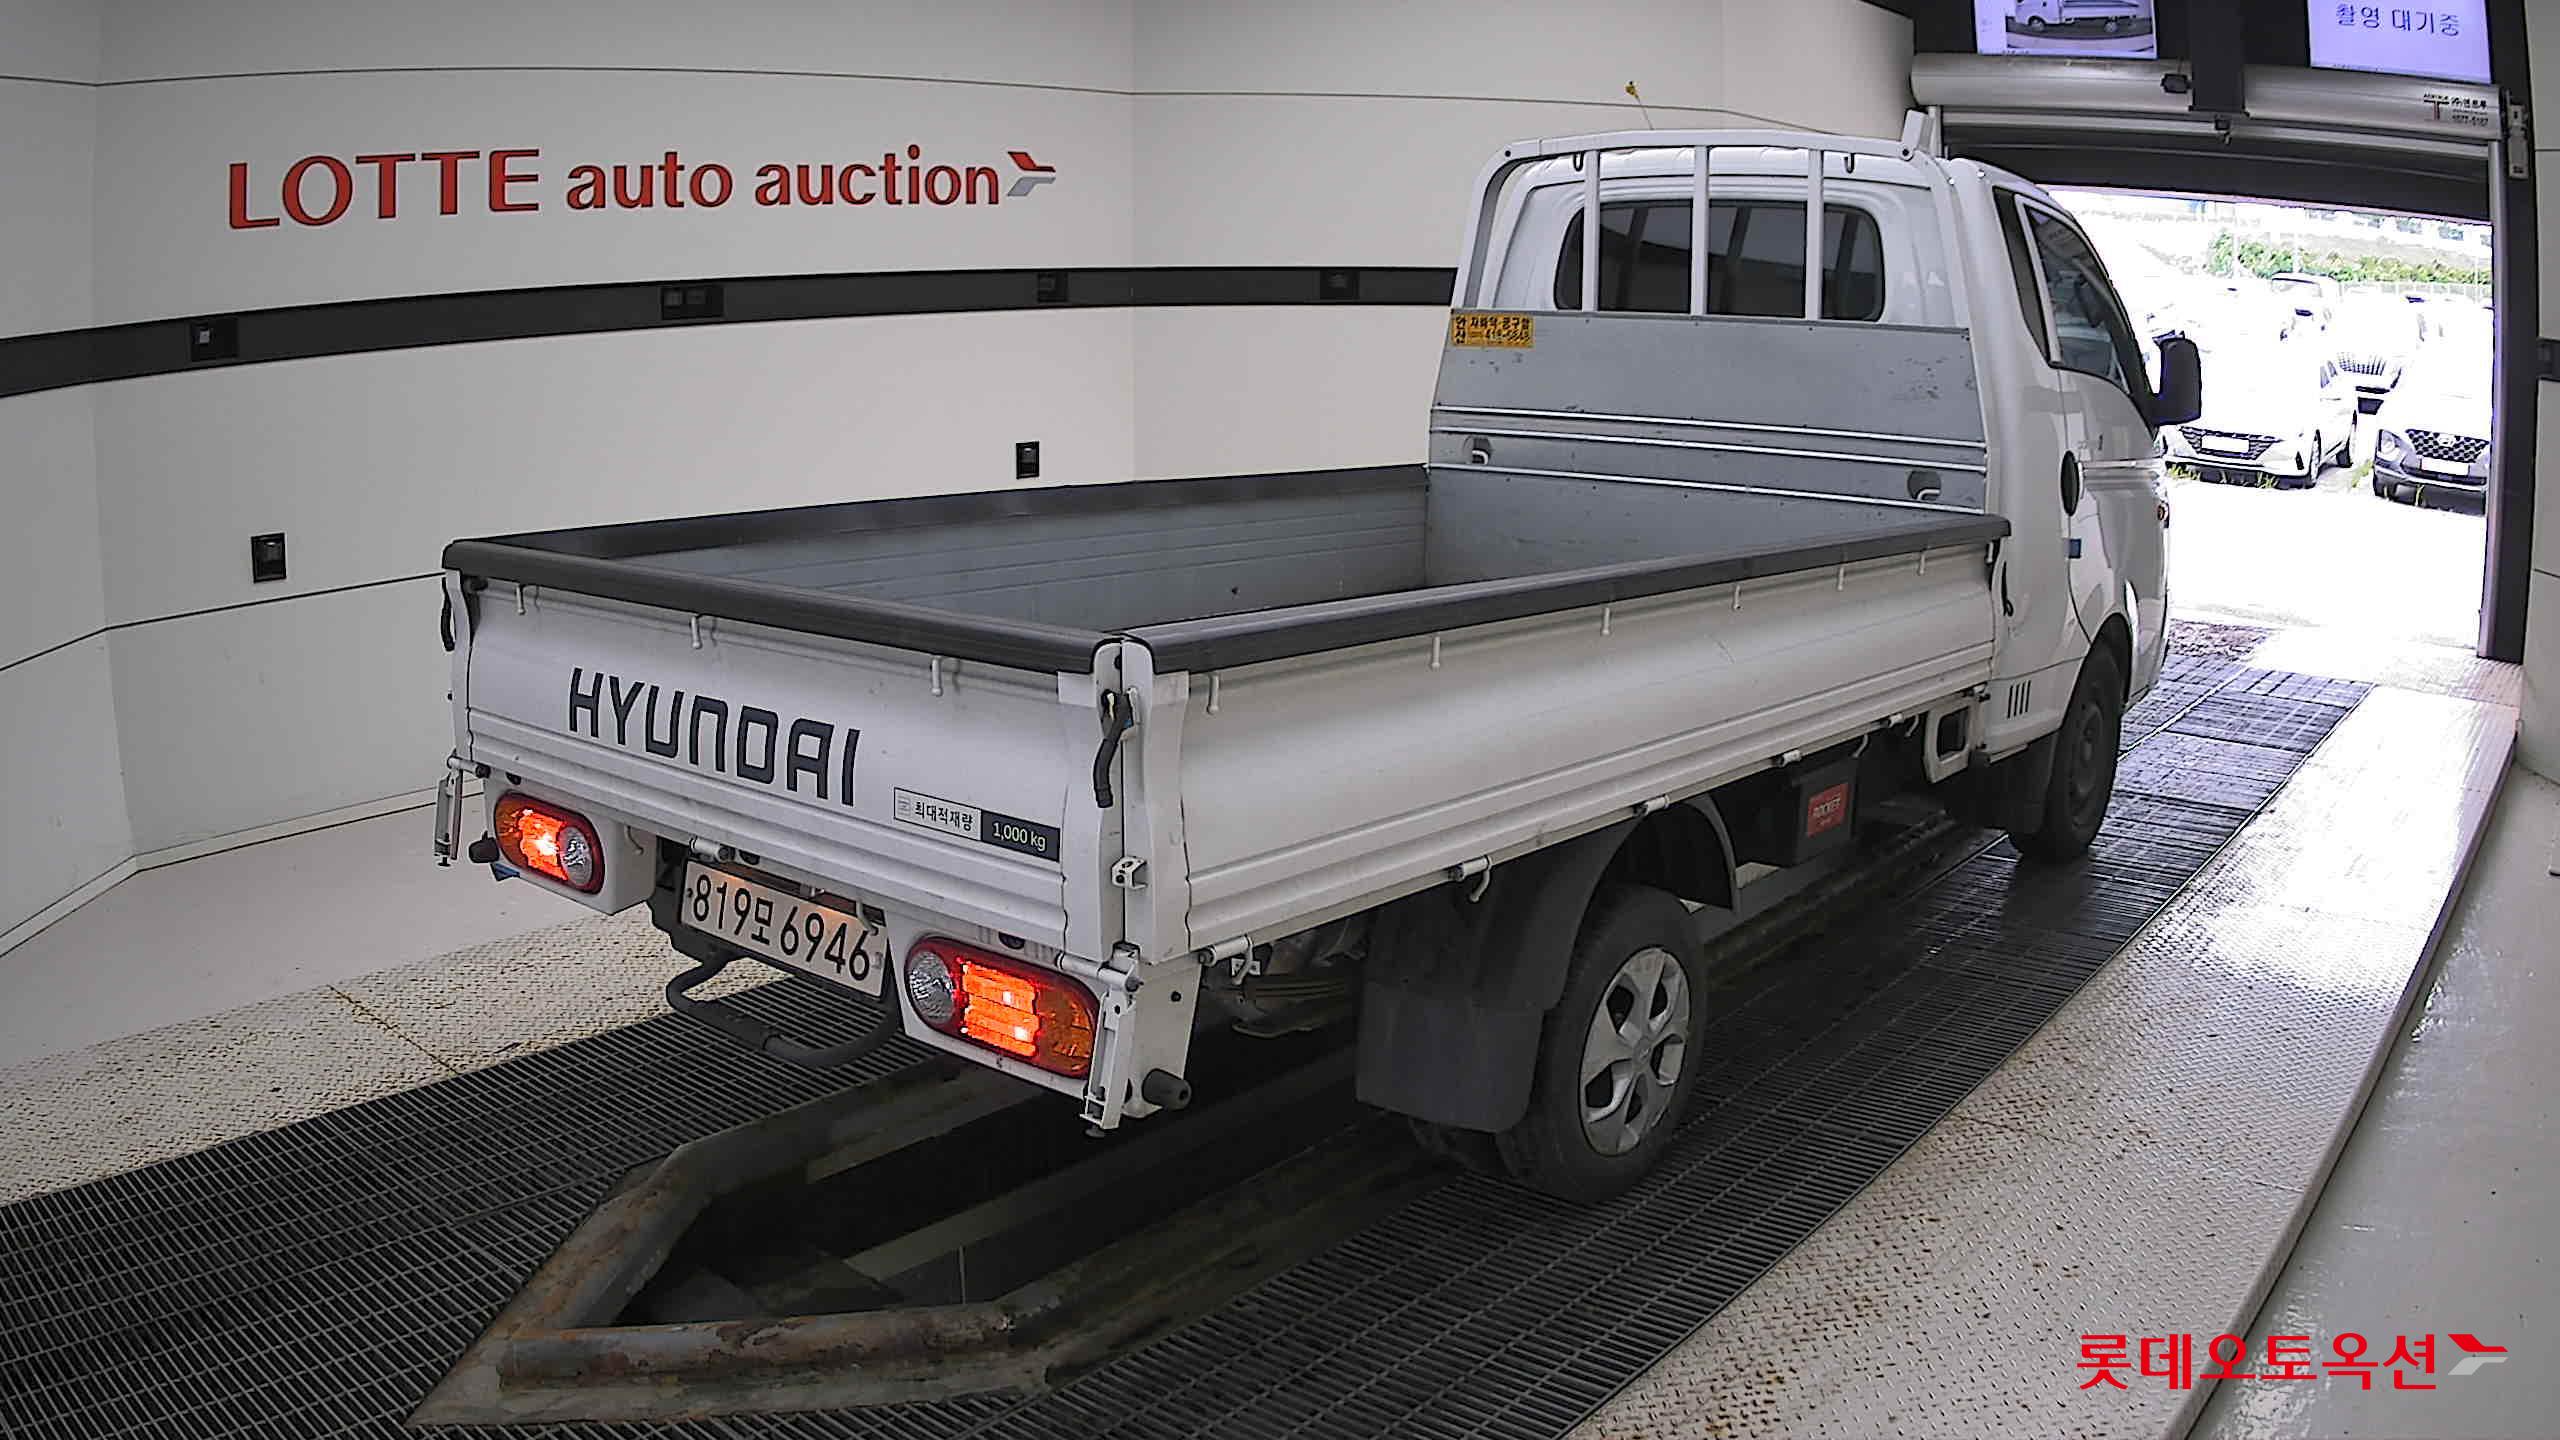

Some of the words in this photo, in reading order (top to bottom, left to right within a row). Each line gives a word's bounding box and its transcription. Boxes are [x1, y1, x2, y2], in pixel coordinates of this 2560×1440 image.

[2336, 4, 2380, 29] 촬영
[2392, 8, 2459, 37] 대기중
[228, 149, 540, 230] LOTTE
[567, 151, 733, 210] auto
[754, 145, 1000, 207] auction
[569, 667, 861, 808] HYUNDAI
[914, 801, 974, 832] 최대적재량
[993, 821, 1028, 844] 1,000
[1030, 830, 1046, 852] kg
